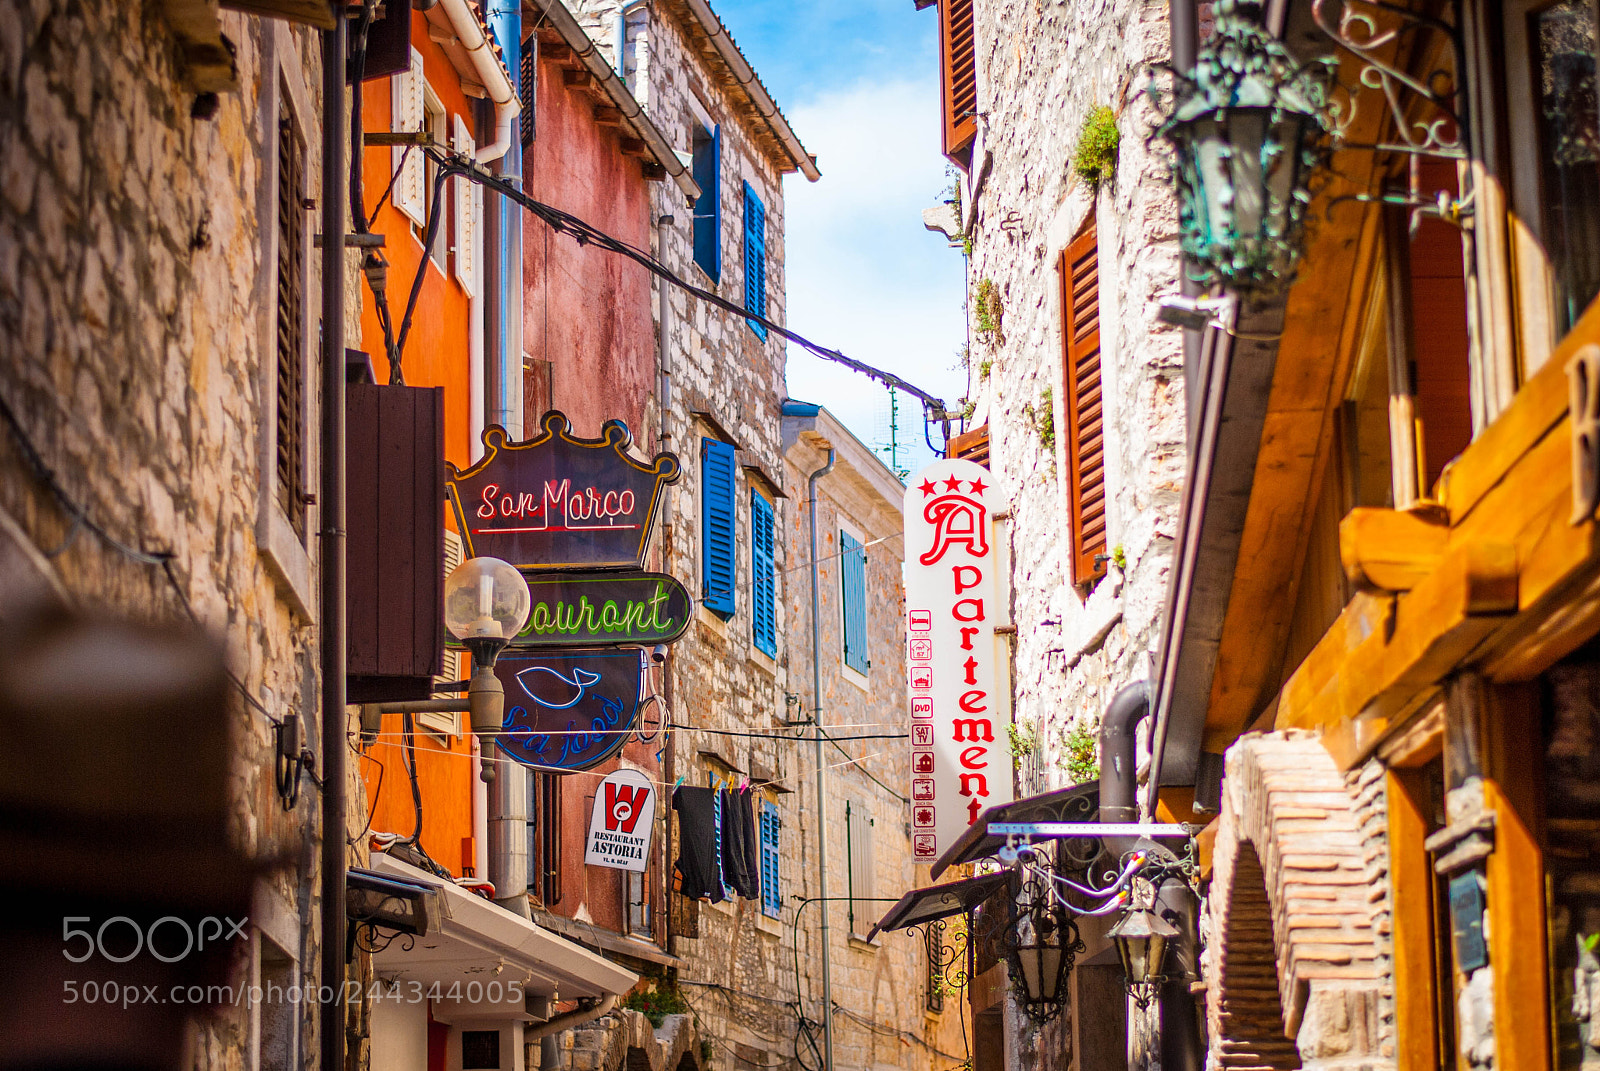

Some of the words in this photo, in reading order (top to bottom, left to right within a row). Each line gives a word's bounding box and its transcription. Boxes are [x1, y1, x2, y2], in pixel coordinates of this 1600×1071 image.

[518, 581, 674, 637] aurant
[919, 494, 995, 826] Apartement
[914, 704, 930, 712] DVD
[915, 726, 930, 736] SAT
[918, 735, 928, 744] TV
[594, 831, 645, 846] RESTAURANT
[592, 841, 643, 860] ASTORIA
